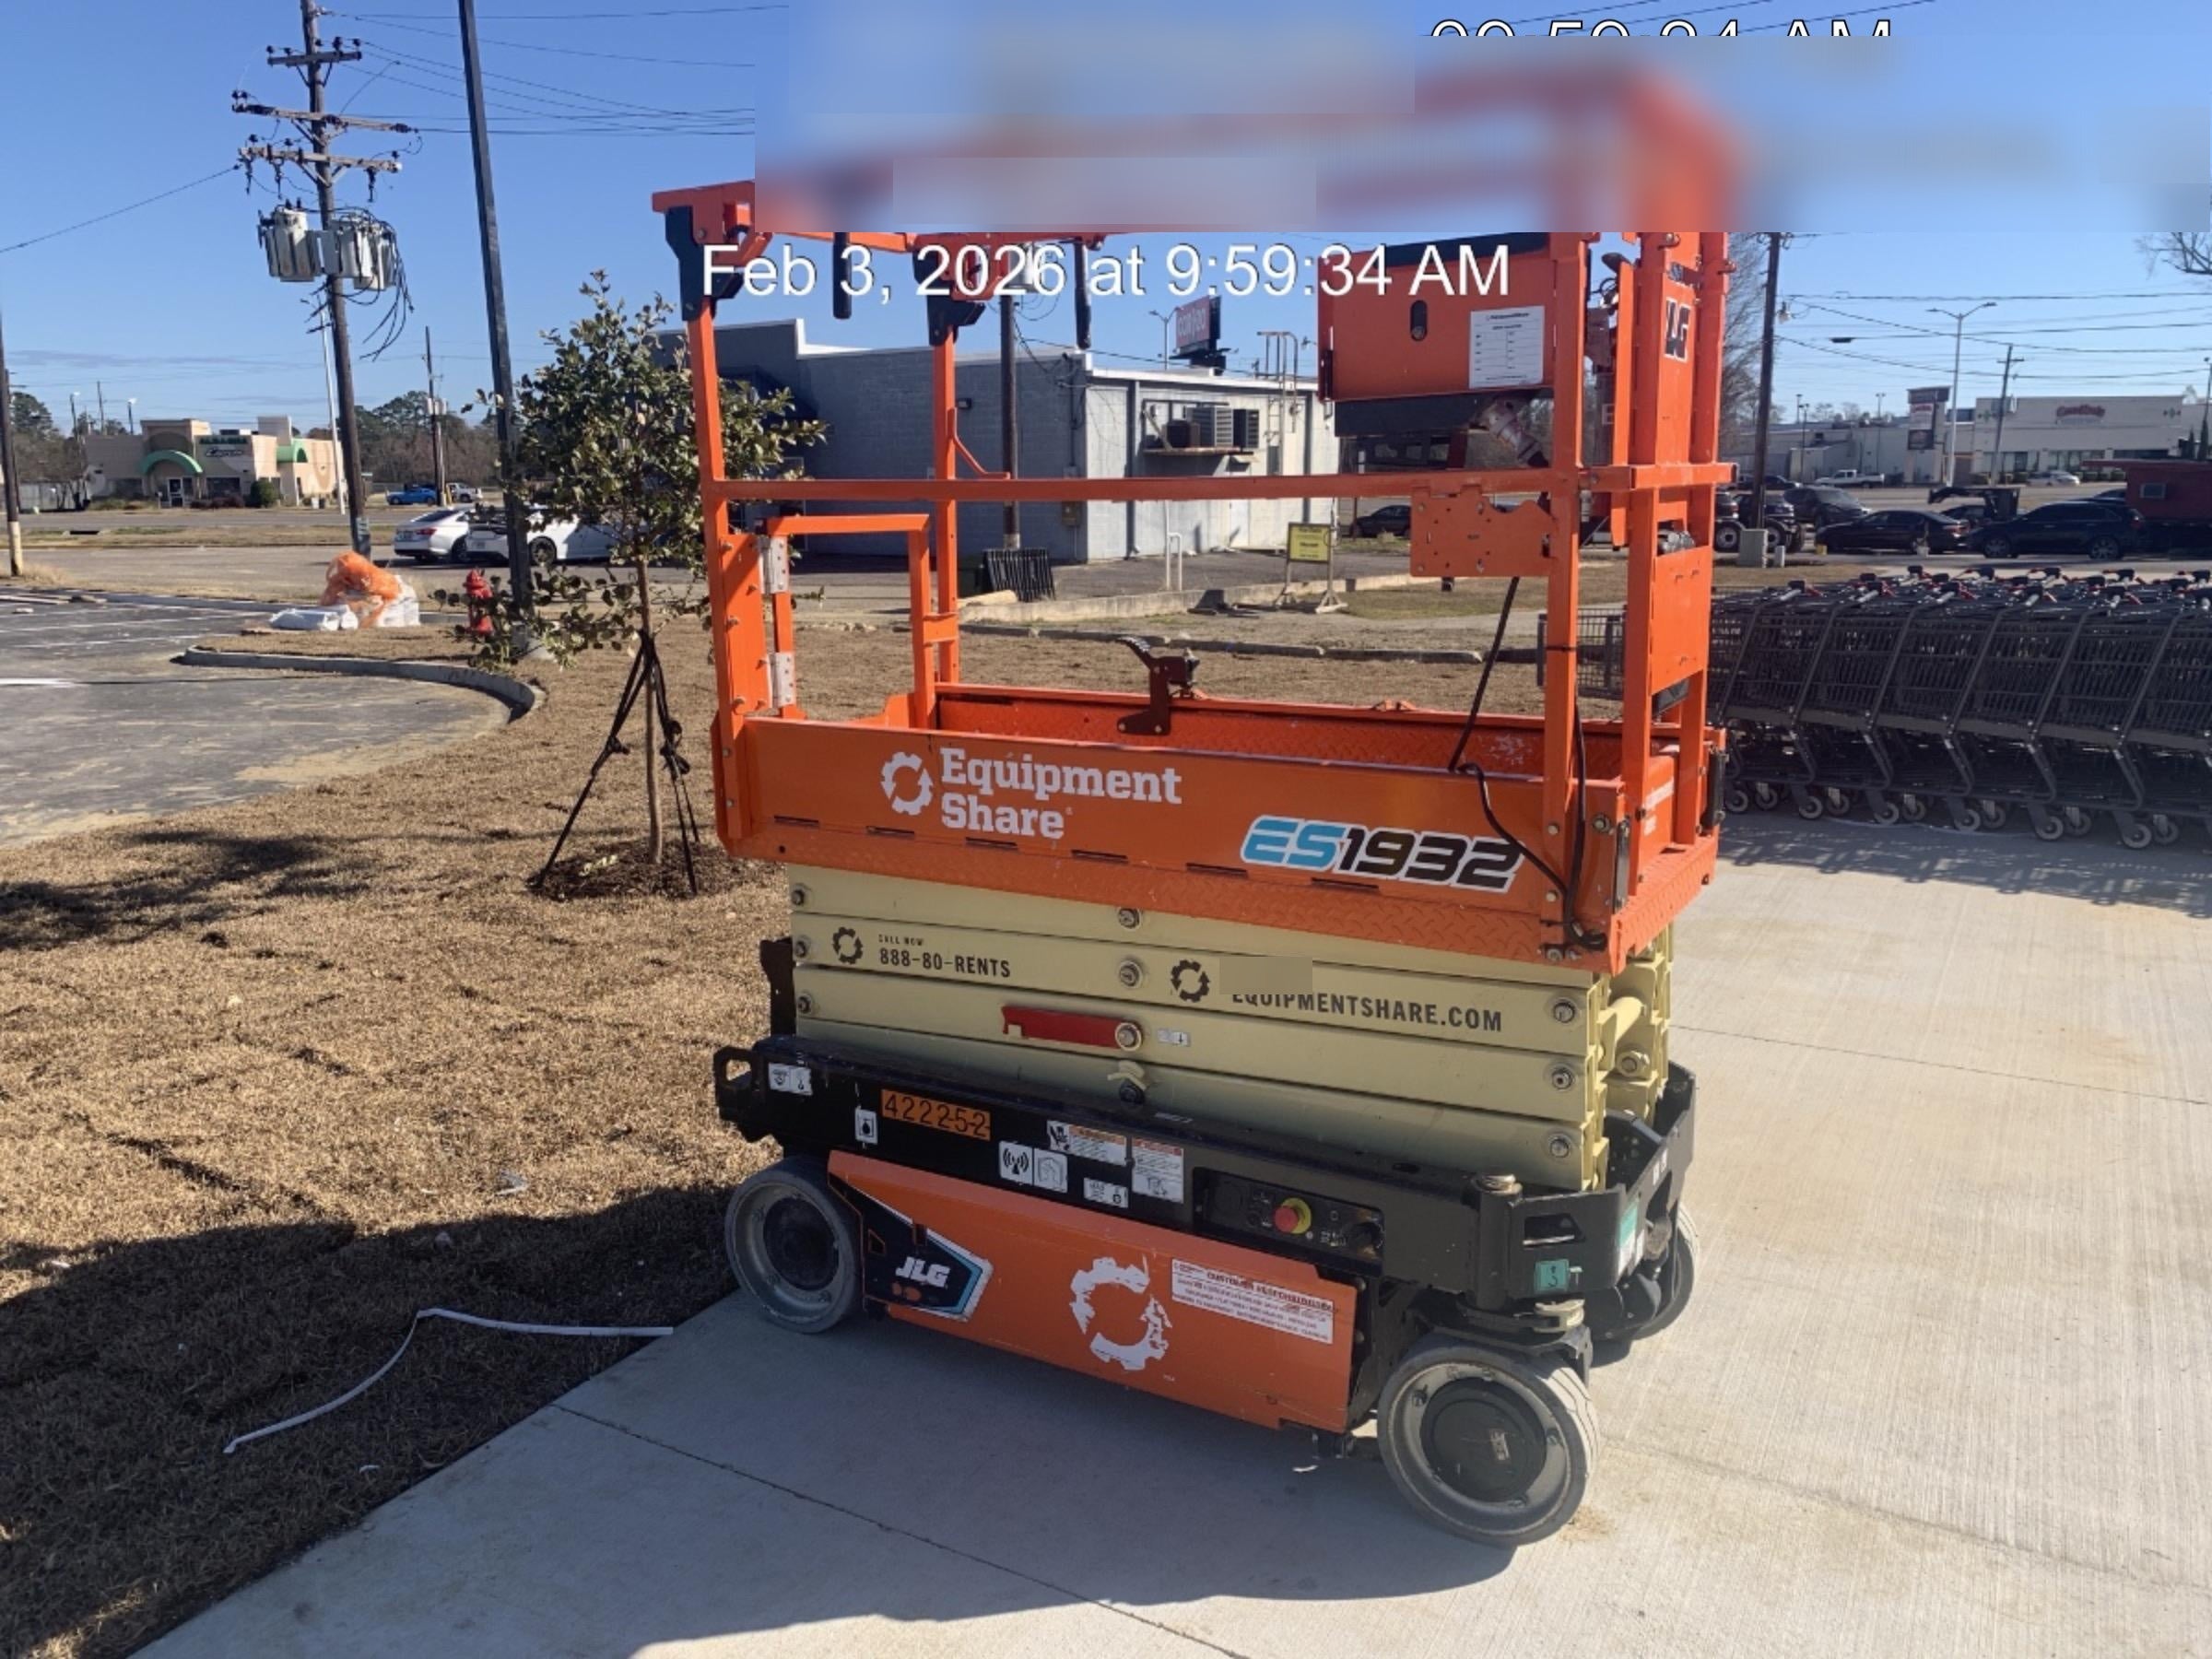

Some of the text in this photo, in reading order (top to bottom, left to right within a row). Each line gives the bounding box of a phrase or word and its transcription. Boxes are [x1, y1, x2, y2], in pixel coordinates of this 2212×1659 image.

[1665, 297, 1692, 363] LG
[939, 747, 1182, 805] Equipment
[940, 792, 1065, 840] Share
[1241, 815, 1525, 893] ES1932
[879, 947, 1011, 978] 888-80-RENTS
[895, 1256, 951, 1288] JLG
